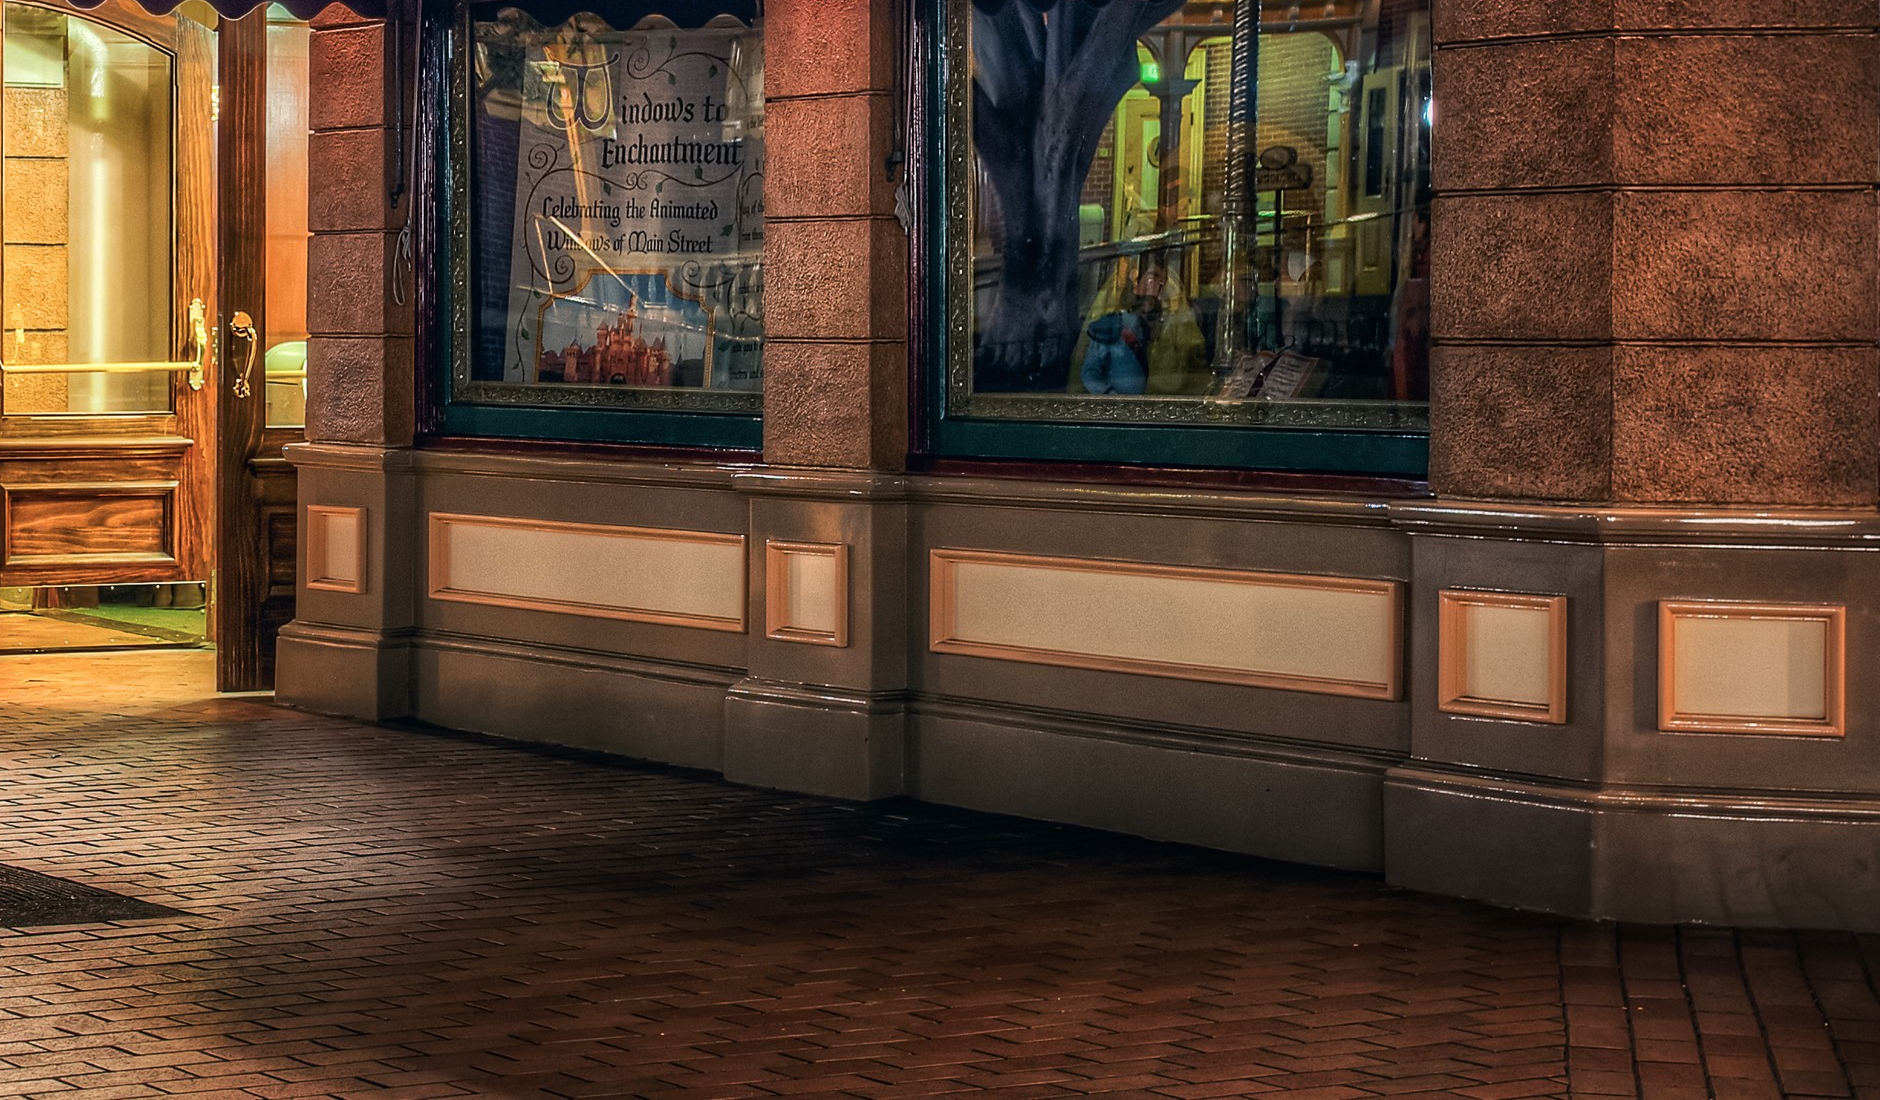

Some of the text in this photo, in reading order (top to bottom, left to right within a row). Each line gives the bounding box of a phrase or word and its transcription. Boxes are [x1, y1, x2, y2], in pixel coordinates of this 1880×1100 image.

[703, 95, 728, 124] to
[601, 133, 744, 170] Enchantment
[543, 196, 621, 228] Celebrating
[626, 197, 646, 219] the
[650, 198, 718, 221] Animated
[547, 230, 611, 252] Windows
[613, 233, 626, 257] of
[627, 230, 664, 256] Main
[667, 228, 714, 254] Street
